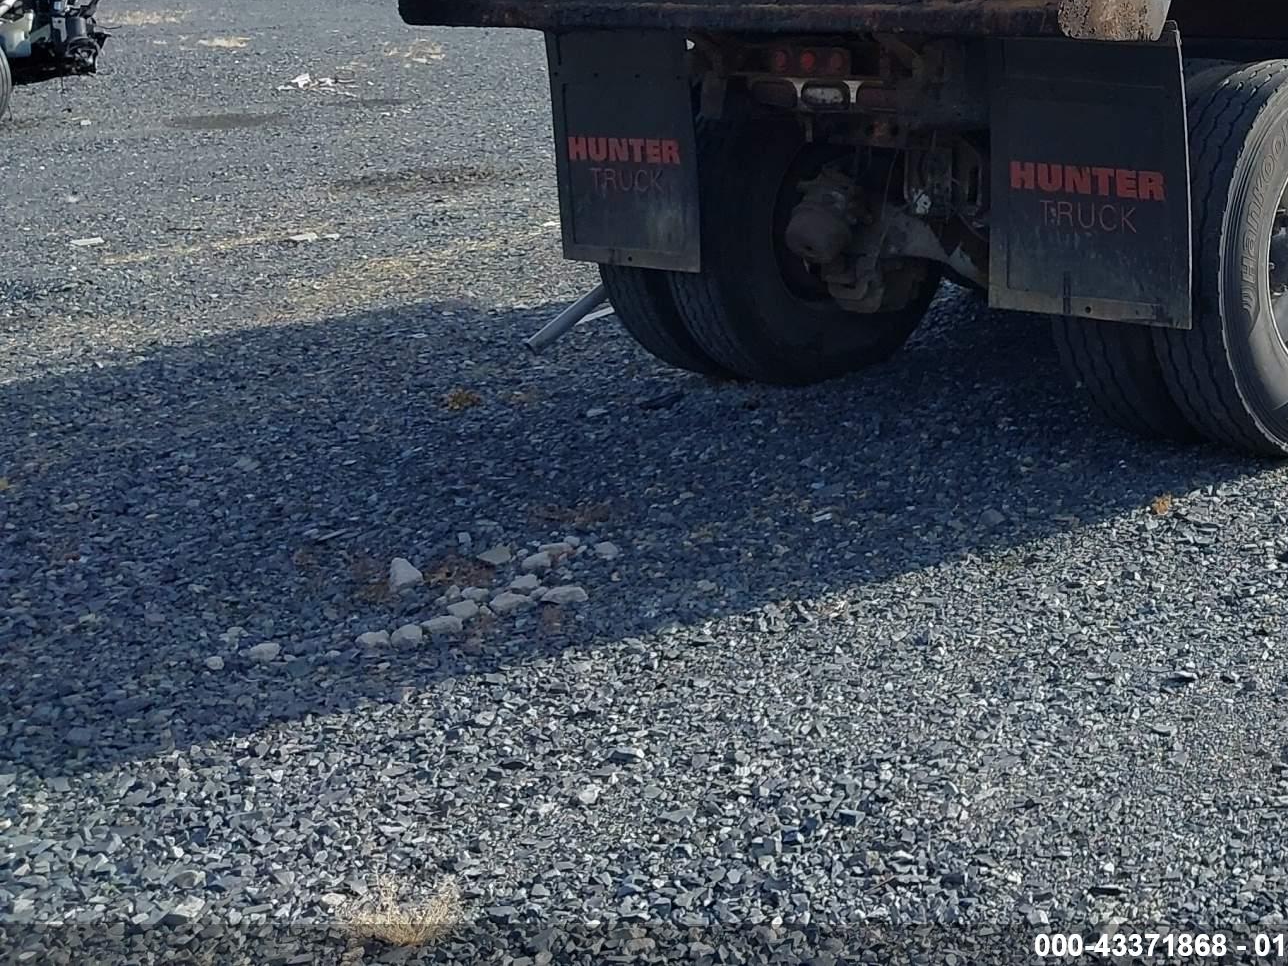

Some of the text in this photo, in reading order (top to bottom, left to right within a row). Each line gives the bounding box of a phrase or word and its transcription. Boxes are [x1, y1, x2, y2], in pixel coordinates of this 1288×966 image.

[567, 136, 680, 164] HUNTER
[589, 167, 663, 192] TRUCK
[1010, 161, 1166, 201] HUNTER
[1040, 200, 1137, 233] TRUCK
